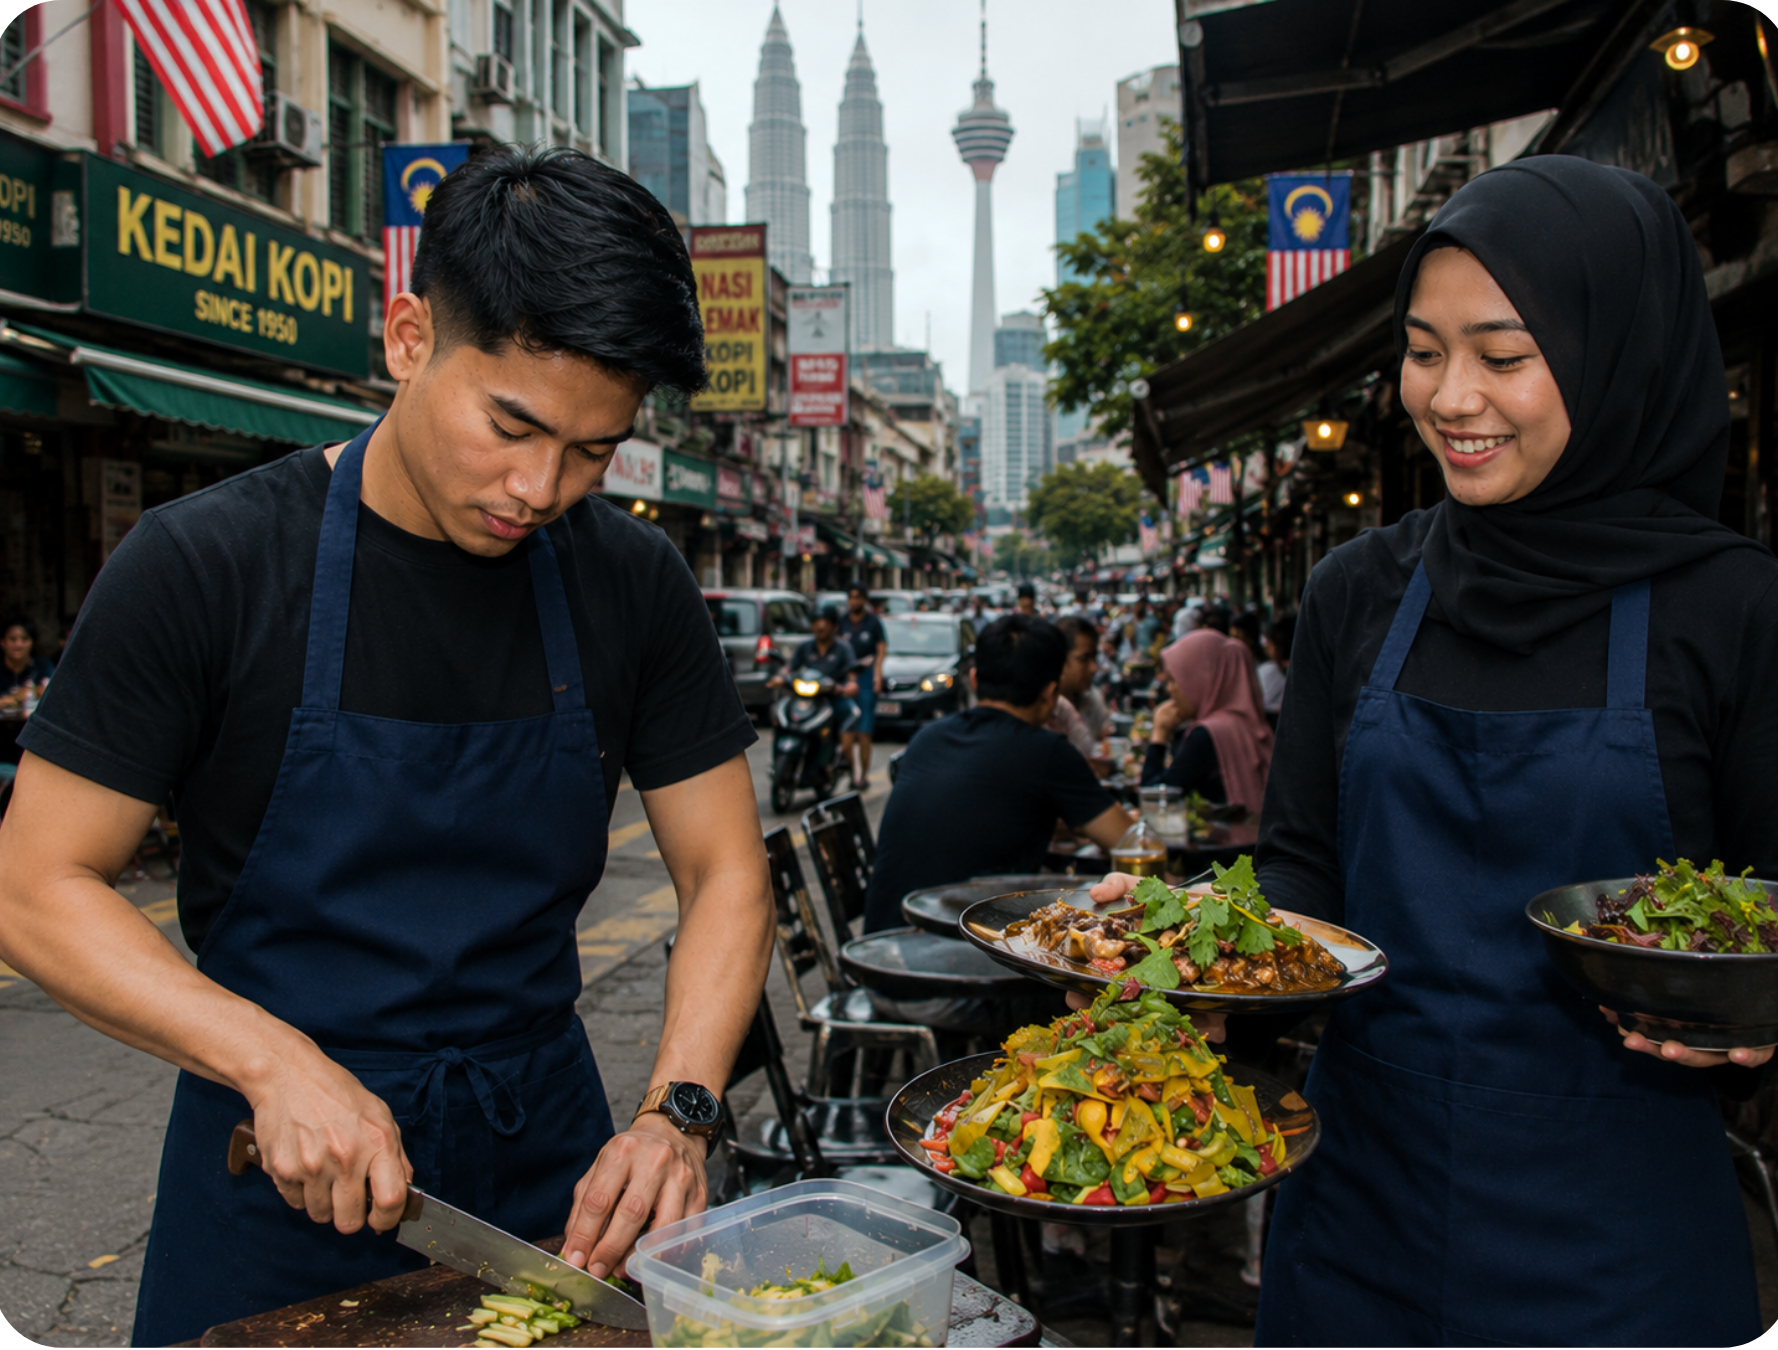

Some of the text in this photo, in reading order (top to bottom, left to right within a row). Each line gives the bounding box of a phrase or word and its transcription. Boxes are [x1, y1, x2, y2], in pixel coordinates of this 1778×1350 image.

[0, 174, 35, 219] OPI
[117, 185, 354, 323] KEDAI KOPI
[701, 271, 753, 301] NASI
[195, 290, 298, 345] SINCE 1950
[705, 306, 760, 334] EMAK
